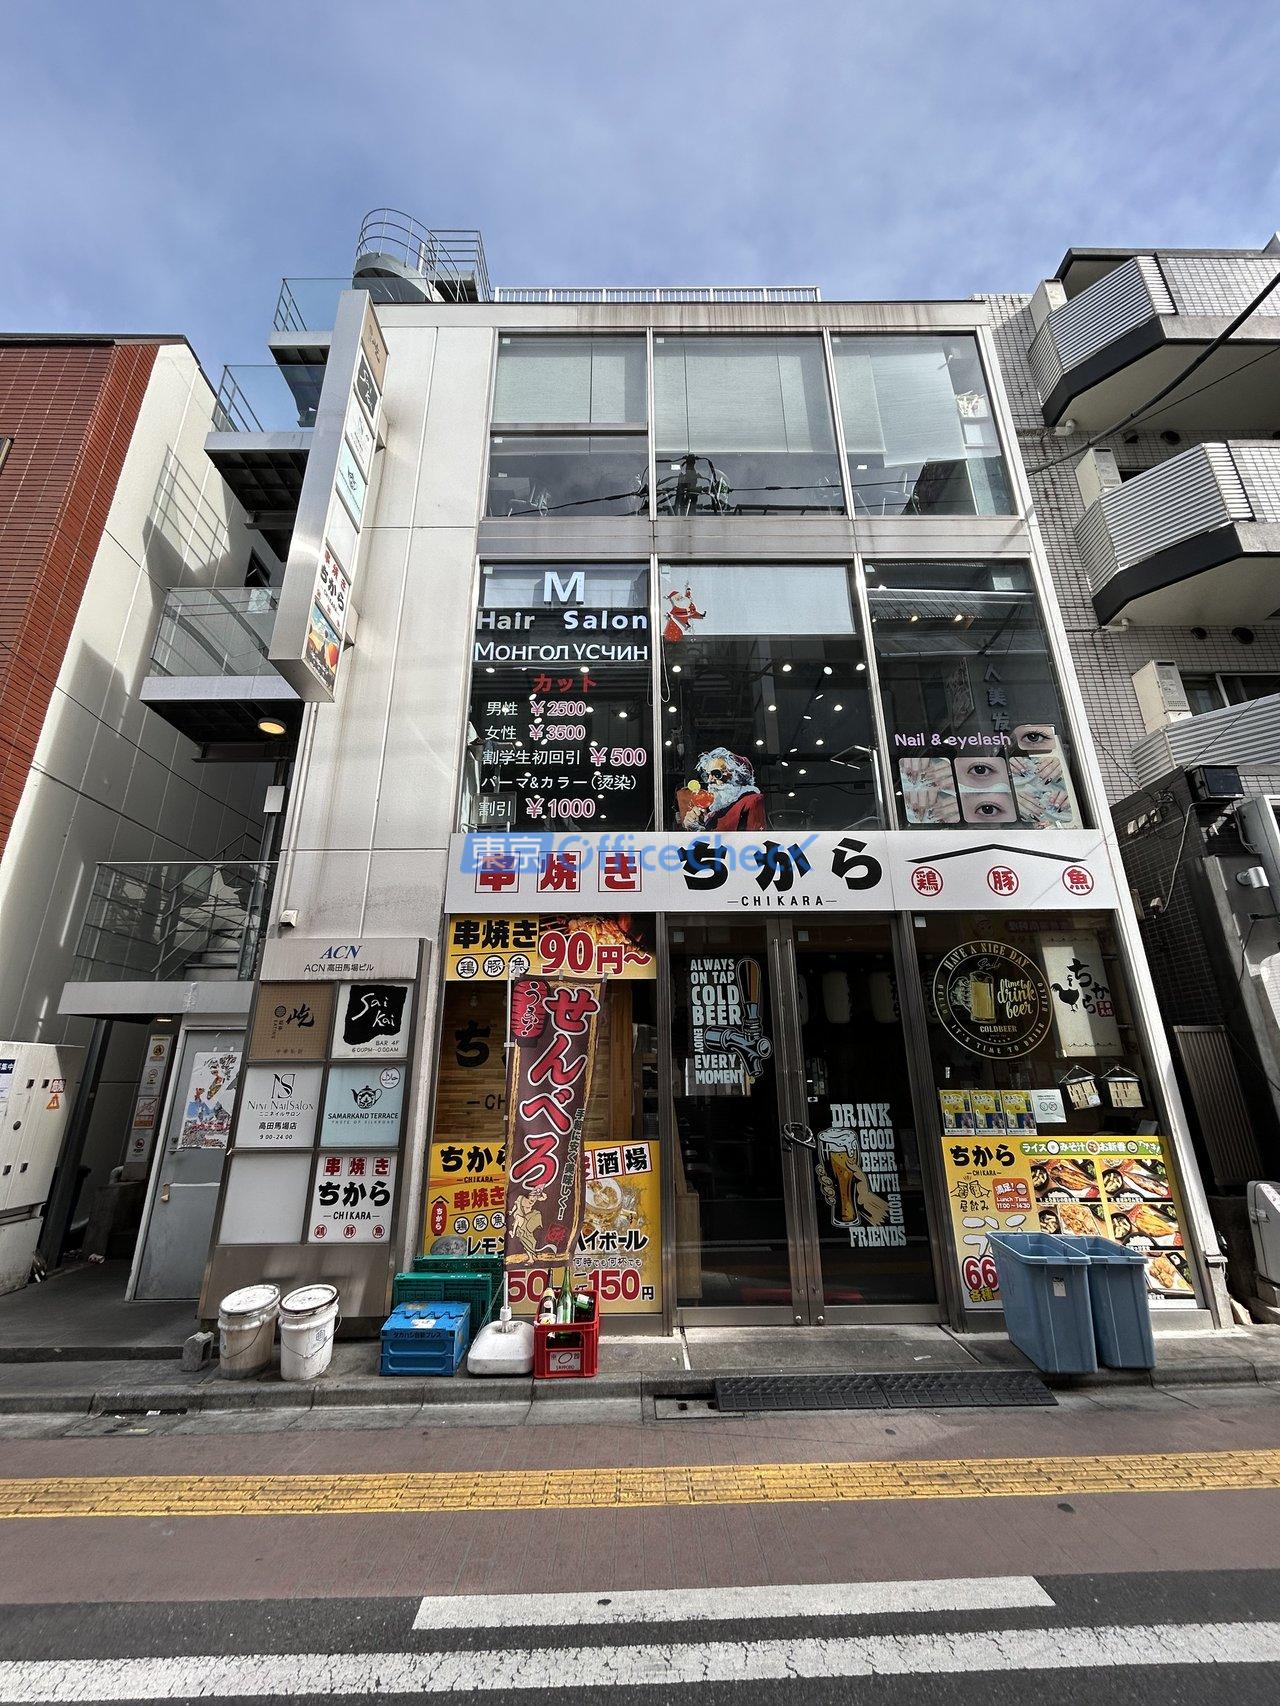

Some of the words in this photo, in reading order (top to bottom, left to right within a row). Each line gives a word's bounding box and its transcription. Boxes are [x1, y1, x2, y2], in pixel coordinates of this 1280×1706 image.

[544, 571, 585, 604] M
[477, 611, 535, 629] Hair
[563, 610, 648, 629] Salon
[532, 674, 597, 693] カット
[486, 701, 518, 716] 男性
[485, 725, 517, 740] 女性
[895, 733, 925, 746] Nail
[931, 733, 942, 746] &
[949, 732, 1011, 749] eyelash
[482, 749, 581, 766] 割学生初回引
[478, 801, 511, 817] 割引
[677, 837, 882, 892] ちから
[916, 871, 939, 890] 鶏
[992, 871, 1015, 891] 豚
[1067, 868, 1091, 890] 魚
[741, 896, 823, 906] CHIKARA
[453, 919, 538, 949] 串焼き
[320, 945, 363, 959] ACN
[943, 947, 968, 970] HAVE
[970, 945, 977, 954] A
[981, 942, 1006, 956] NICE
[1009, 951, 1029, 968] DAY
[304, 964, 325, 972] ACN
[327, 963, 374, 972] 高田馬場ビル
[690, 959, 735, 971] ALWAYS
[690, 972, 707, 985] ON
[712, 972, 735, 984] TAP
[692, 985, 739, 1006] COLD
[997, 979, 1036, 1004] drink
[351, 993, 389, 1020] Sai
[692, 1005, 742, 1026] BEER
[1006, 1001, 1034, 1019] beer
[372, 1010, 395, 1027] Kai
[980, 1025, 1018, 1033] COLDBEER
[693, 1028, 704, 1054] ENJOY
[976, 1042, 1001, 1054] TIME
[694, 1054, 737, 1069] EVERY
[695, 1069, 744, 1085] MOMENT
[510, 987, 600, 1190] せんべろ
[830, 1103, 892, 1128] DRINK
[259, 1122, 298, 1130] 高田馬場店
[860, 1128, 896, 1150] GOOD
[1022, 1142, 1047, 1153] ライス
[1060, 1141, 1085, 1152] みそ汁
[860, 1151, 898, 1172] BEER
[950, 1143, 1015, 1167] ちから
[325, 1158, 389, 1176] 串焼き
[464, 1176, 494, 1184] CHIKARA
[867, 1174, 901, 1192] WITH
[318, 1180, 391, 1207] ちから
[453, 1185, 505, 1211] 串焼き
[333, 1211, 371, 1220] CHIKARA
[887, 1193, 904, 1224] GOOD
[849, 1226, 907, 1248] FRIENDS
[573, 1257, 642, 1268] 何時でも何杯でも
[588, 1268, 655, 1301] 150円
